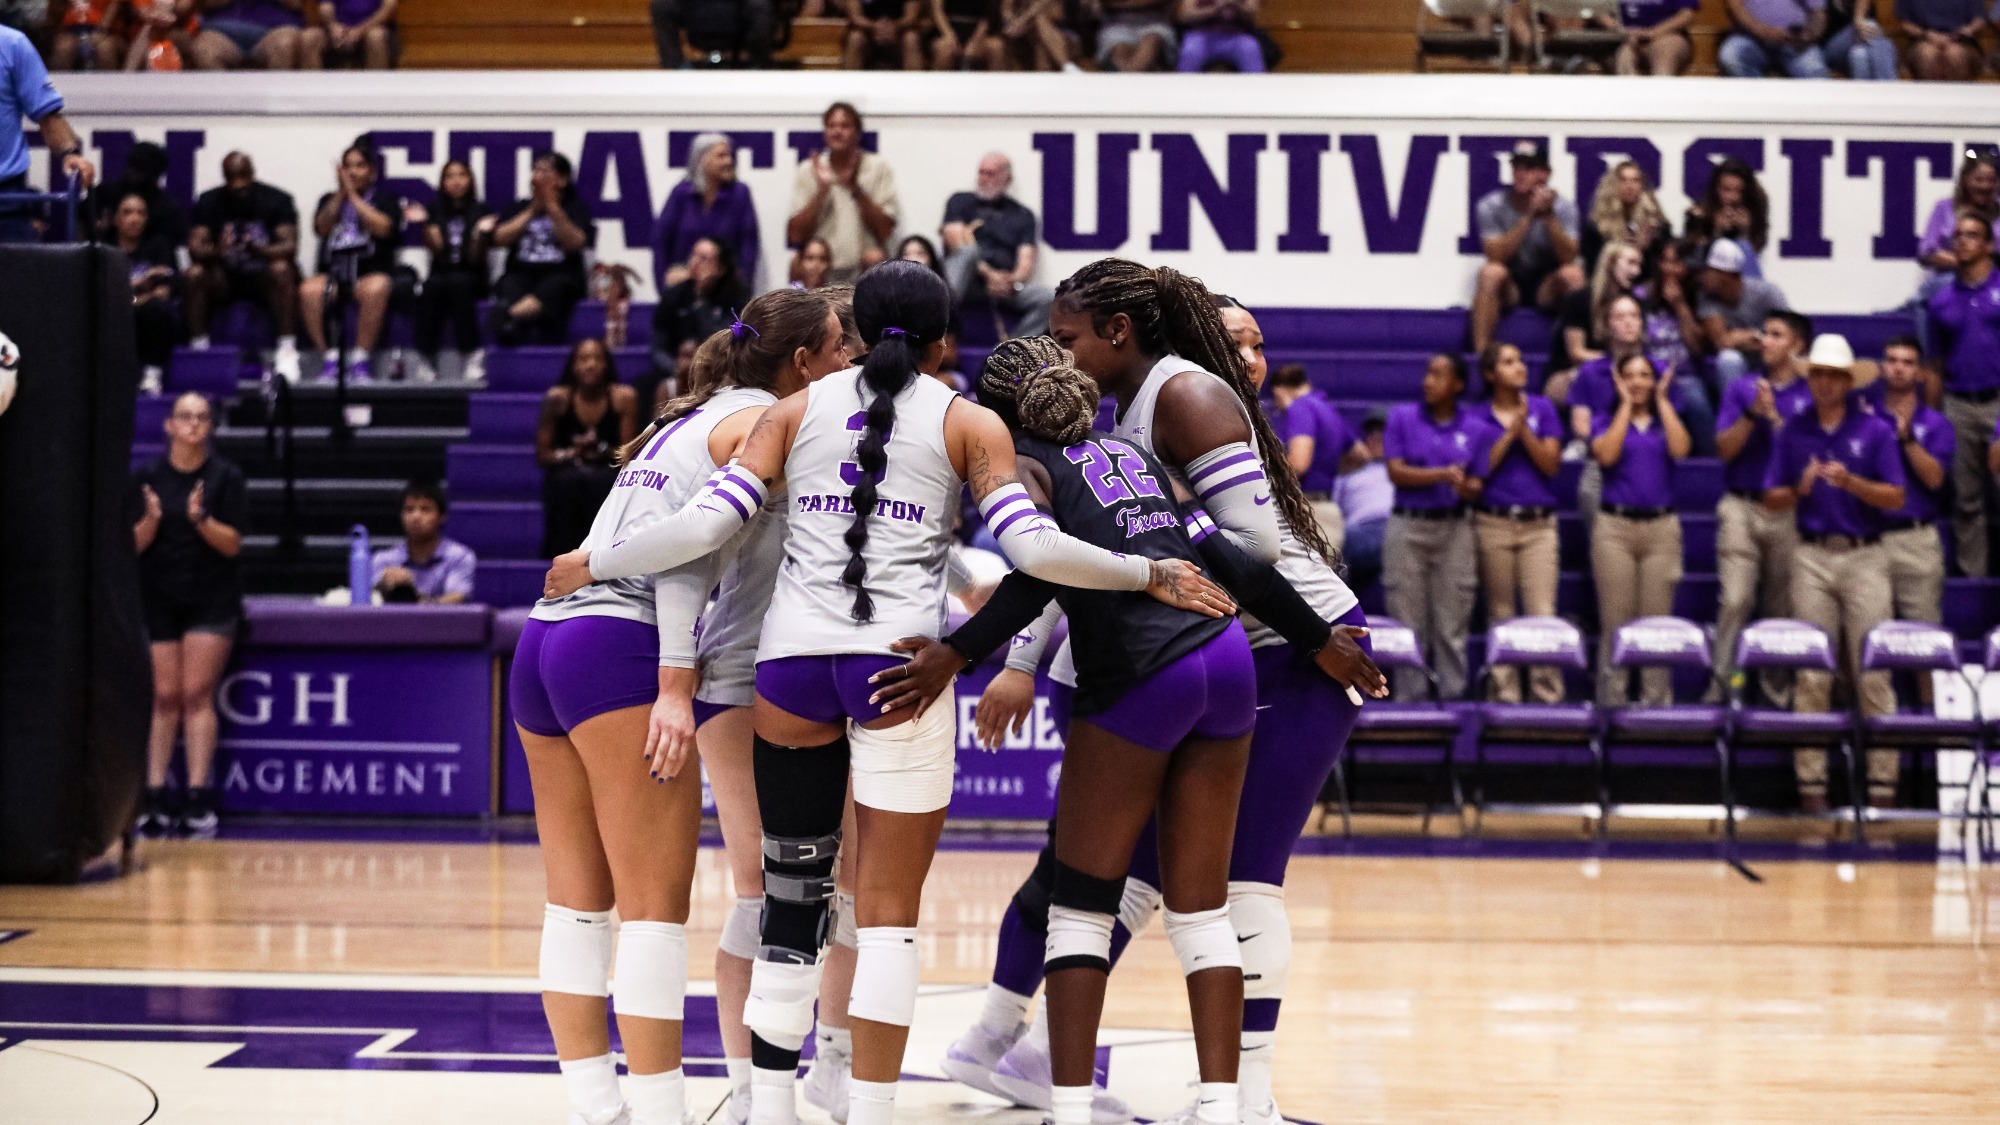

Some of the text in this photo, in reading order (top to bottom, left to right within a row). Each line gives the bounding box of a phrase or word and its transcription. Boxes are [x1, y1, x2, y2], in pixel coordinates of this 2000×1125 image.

[839, 410, 894, 486] 3
[1063, 439, 1166, 508] 22
[798, 494, 926, 525] TARLTON
[212, 758, 461, 796] AGEMENT
